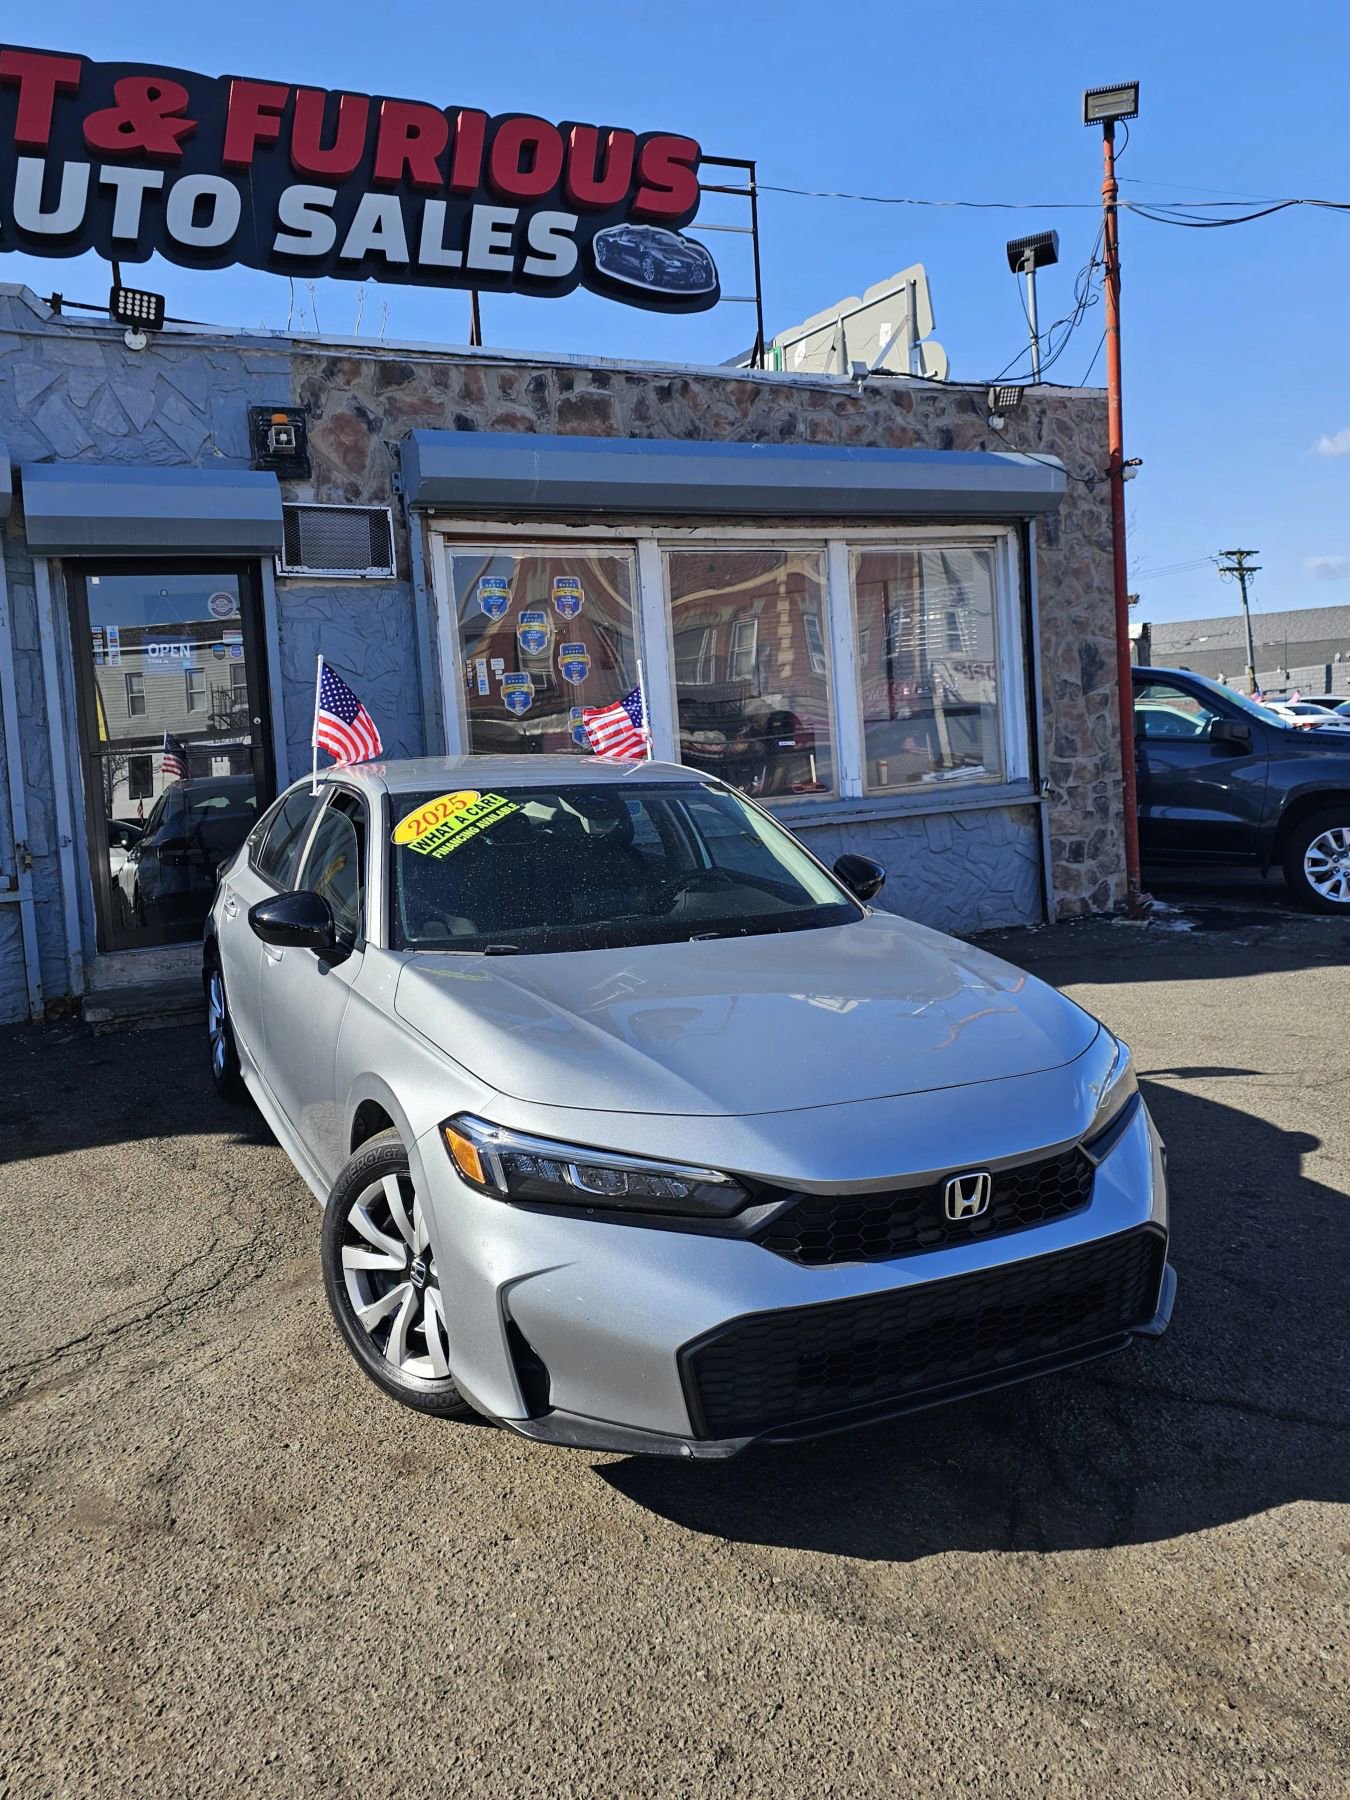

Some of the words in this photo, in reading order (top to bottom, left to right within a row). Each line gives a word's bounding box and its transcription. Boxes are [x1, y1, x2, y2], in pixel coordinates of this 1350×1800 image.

[83, 77, 197, 161] &
[223, 80, 699, 217] FURIOUS
[0, 157, 241, 248] UTO
[273, 185, 578, 278] SALES
[148, 643, 191, 657] OPEN
[407, 795, 468, 837] 2025
[413, 821, 454, 851] WHAT
[454, 815, 467, 825] A
[466, 795, 500, 816] CAR!
[431, 825, 480, 859] FINANCING
[480, 802, 520, 830] AVAILABLE
[383, 1148, 398, 1159] GT
